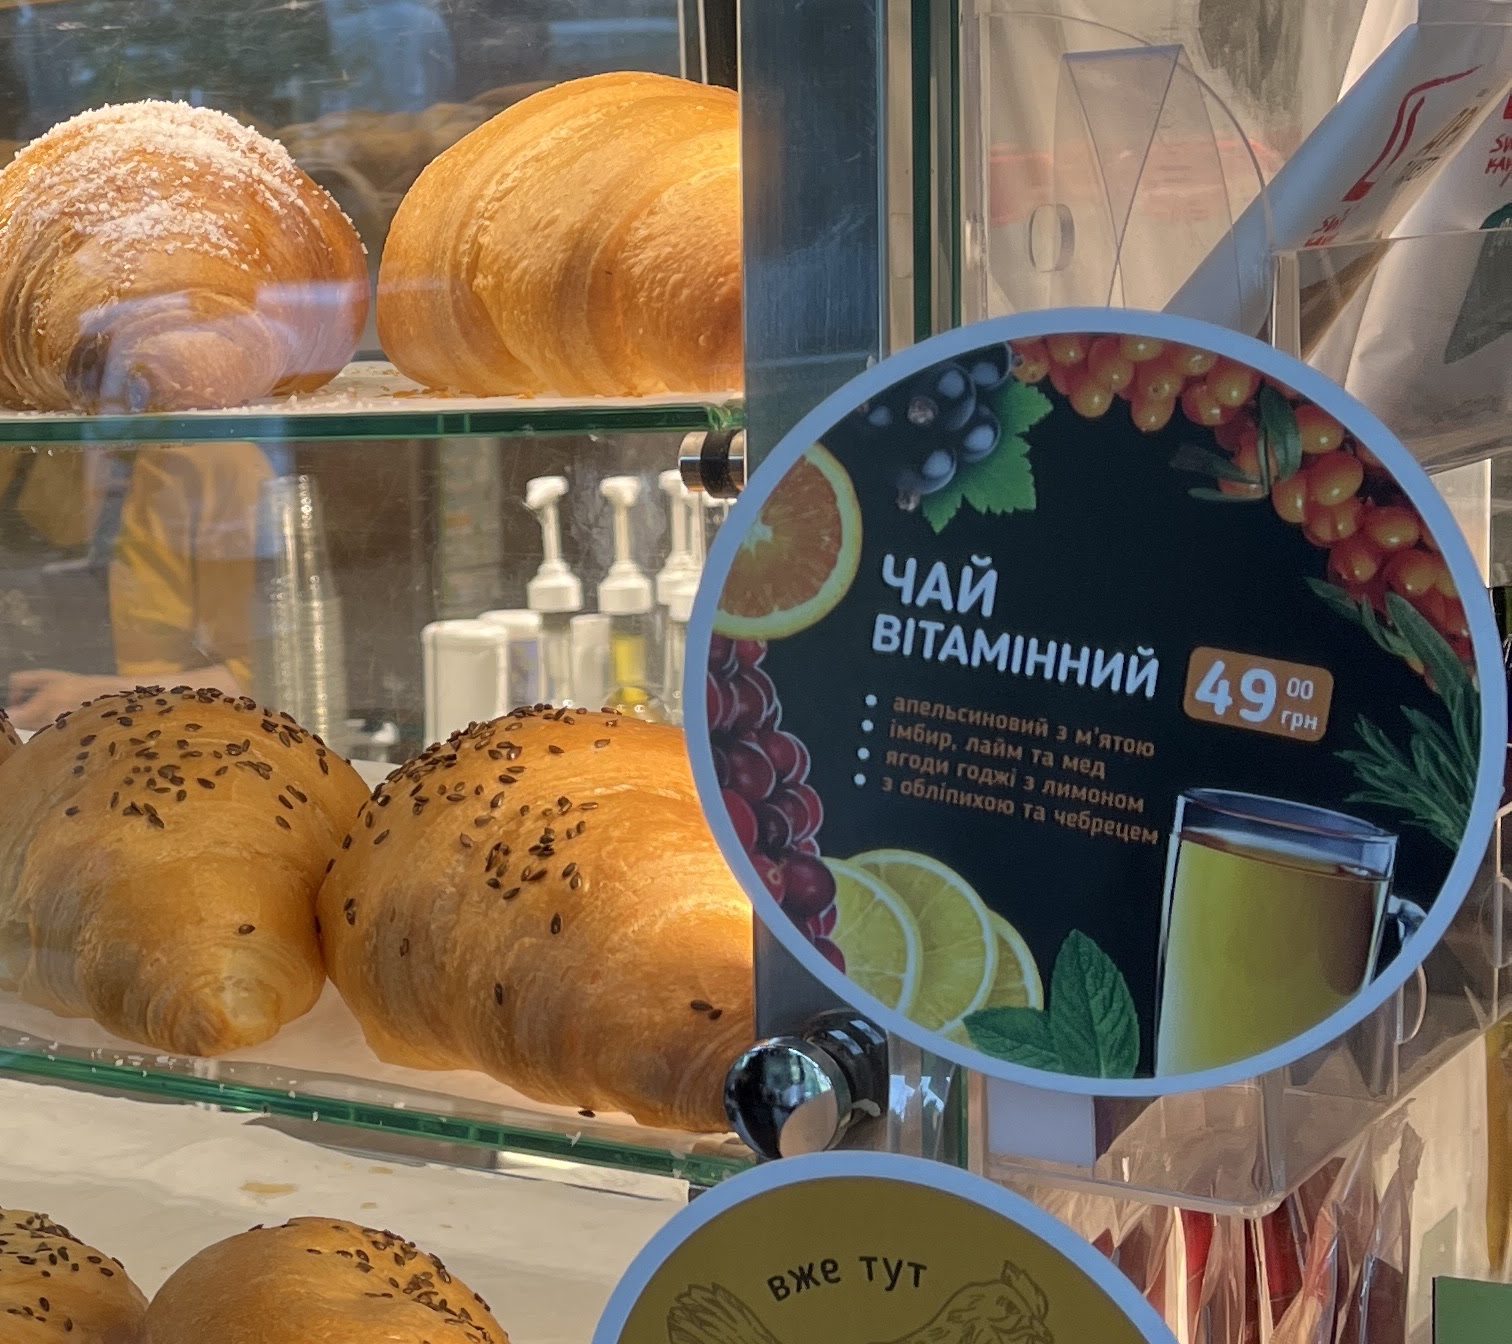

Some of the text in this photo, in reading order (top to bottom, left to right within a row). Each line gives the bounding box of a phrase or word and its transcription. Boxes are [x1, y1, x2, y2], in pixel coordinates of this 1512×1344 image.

[881, 553, 998, 618] ЧАЙ
[872, 611, 1159, 698] ВІТАМІННИЙ
[1194, 658, 1315, 723] 49 00
[1280, 708, 1318, 733] грн
[889, 718, 1106, 781] імбир, лайм та мед
[892, 694, 1156, 758] апельсиновий з м'ятою
[881, 775, 1159, 846] з обліпихою та чебрецем
[884, 748, 1145, 814] ягоди годжі з лимоном
[766, 1253, 929, 1304] вже тут
